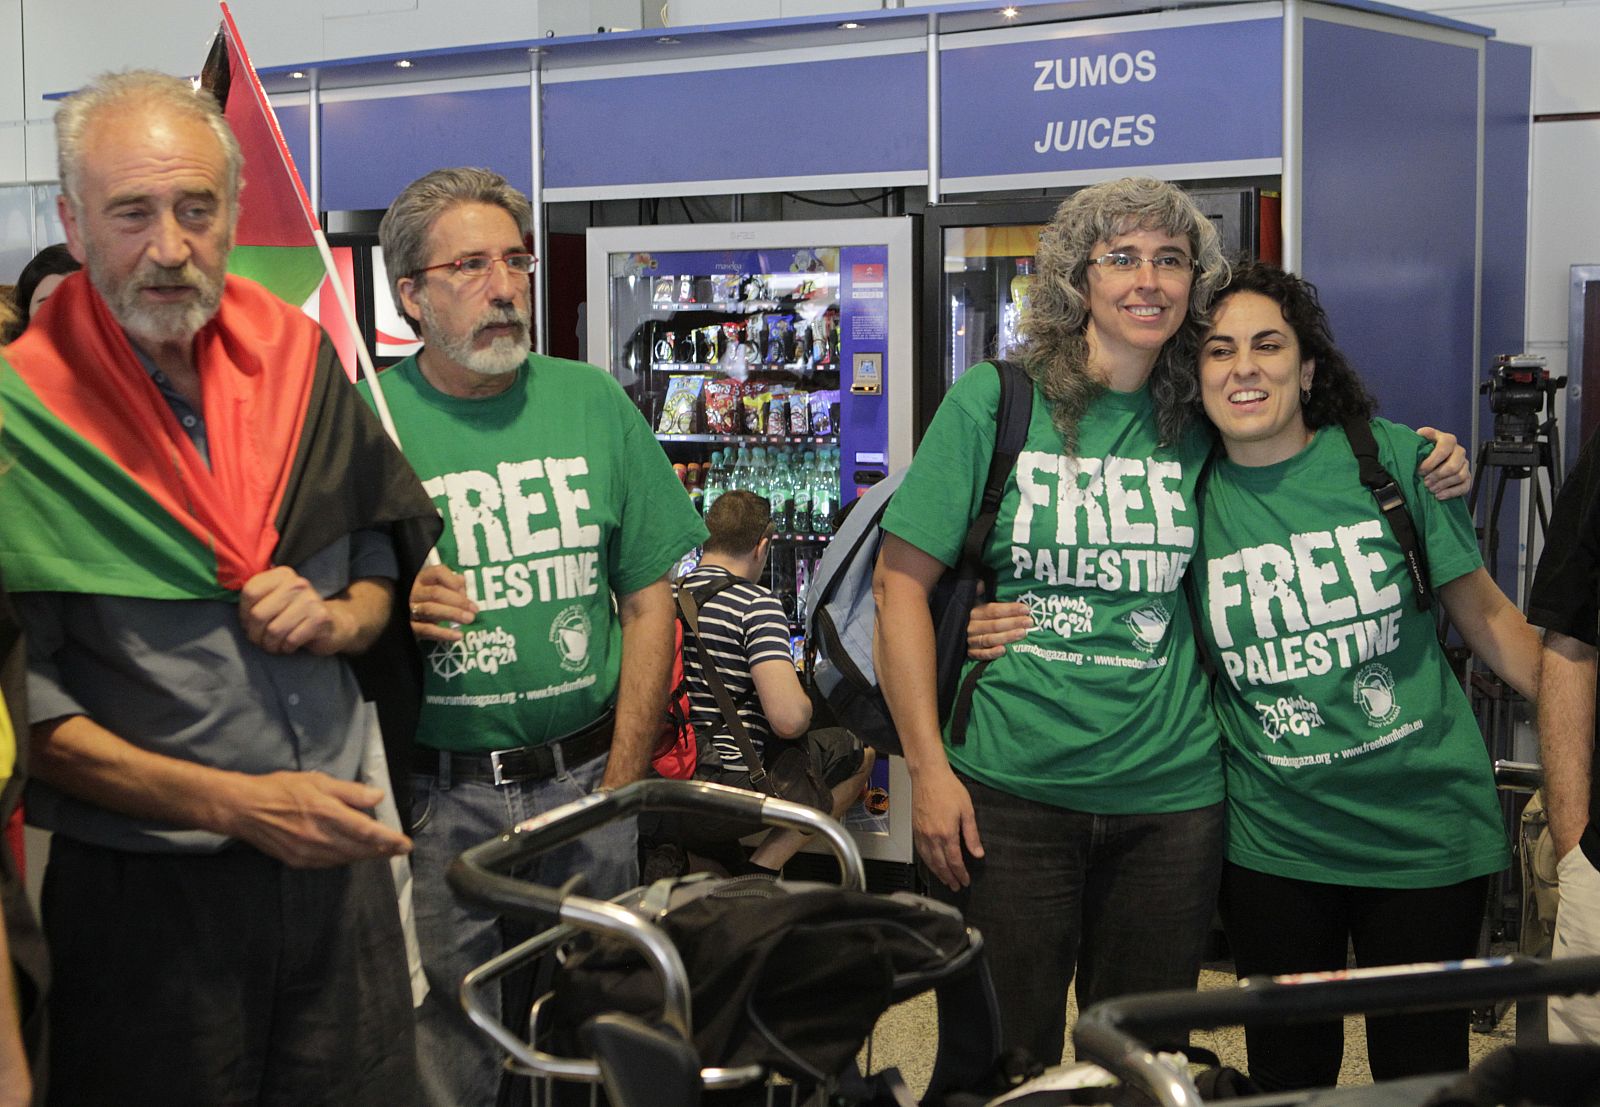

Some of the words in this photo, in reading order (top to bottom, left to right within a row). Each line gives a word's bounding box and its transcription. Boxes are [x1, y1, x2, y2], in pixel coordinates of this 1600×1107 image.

[1033, 50, 1157, 92] ZUMOS
[1034, 114, 1156, 153] JUICES
[421, 456, 600, 567] REE
[1011, 451, 1195, 548] FREE
[463, 551, 599, 612] LESTINE
[1208, 519, 1401, 649] FREE
[1221, 608, 1403, 692] PALESTINE
